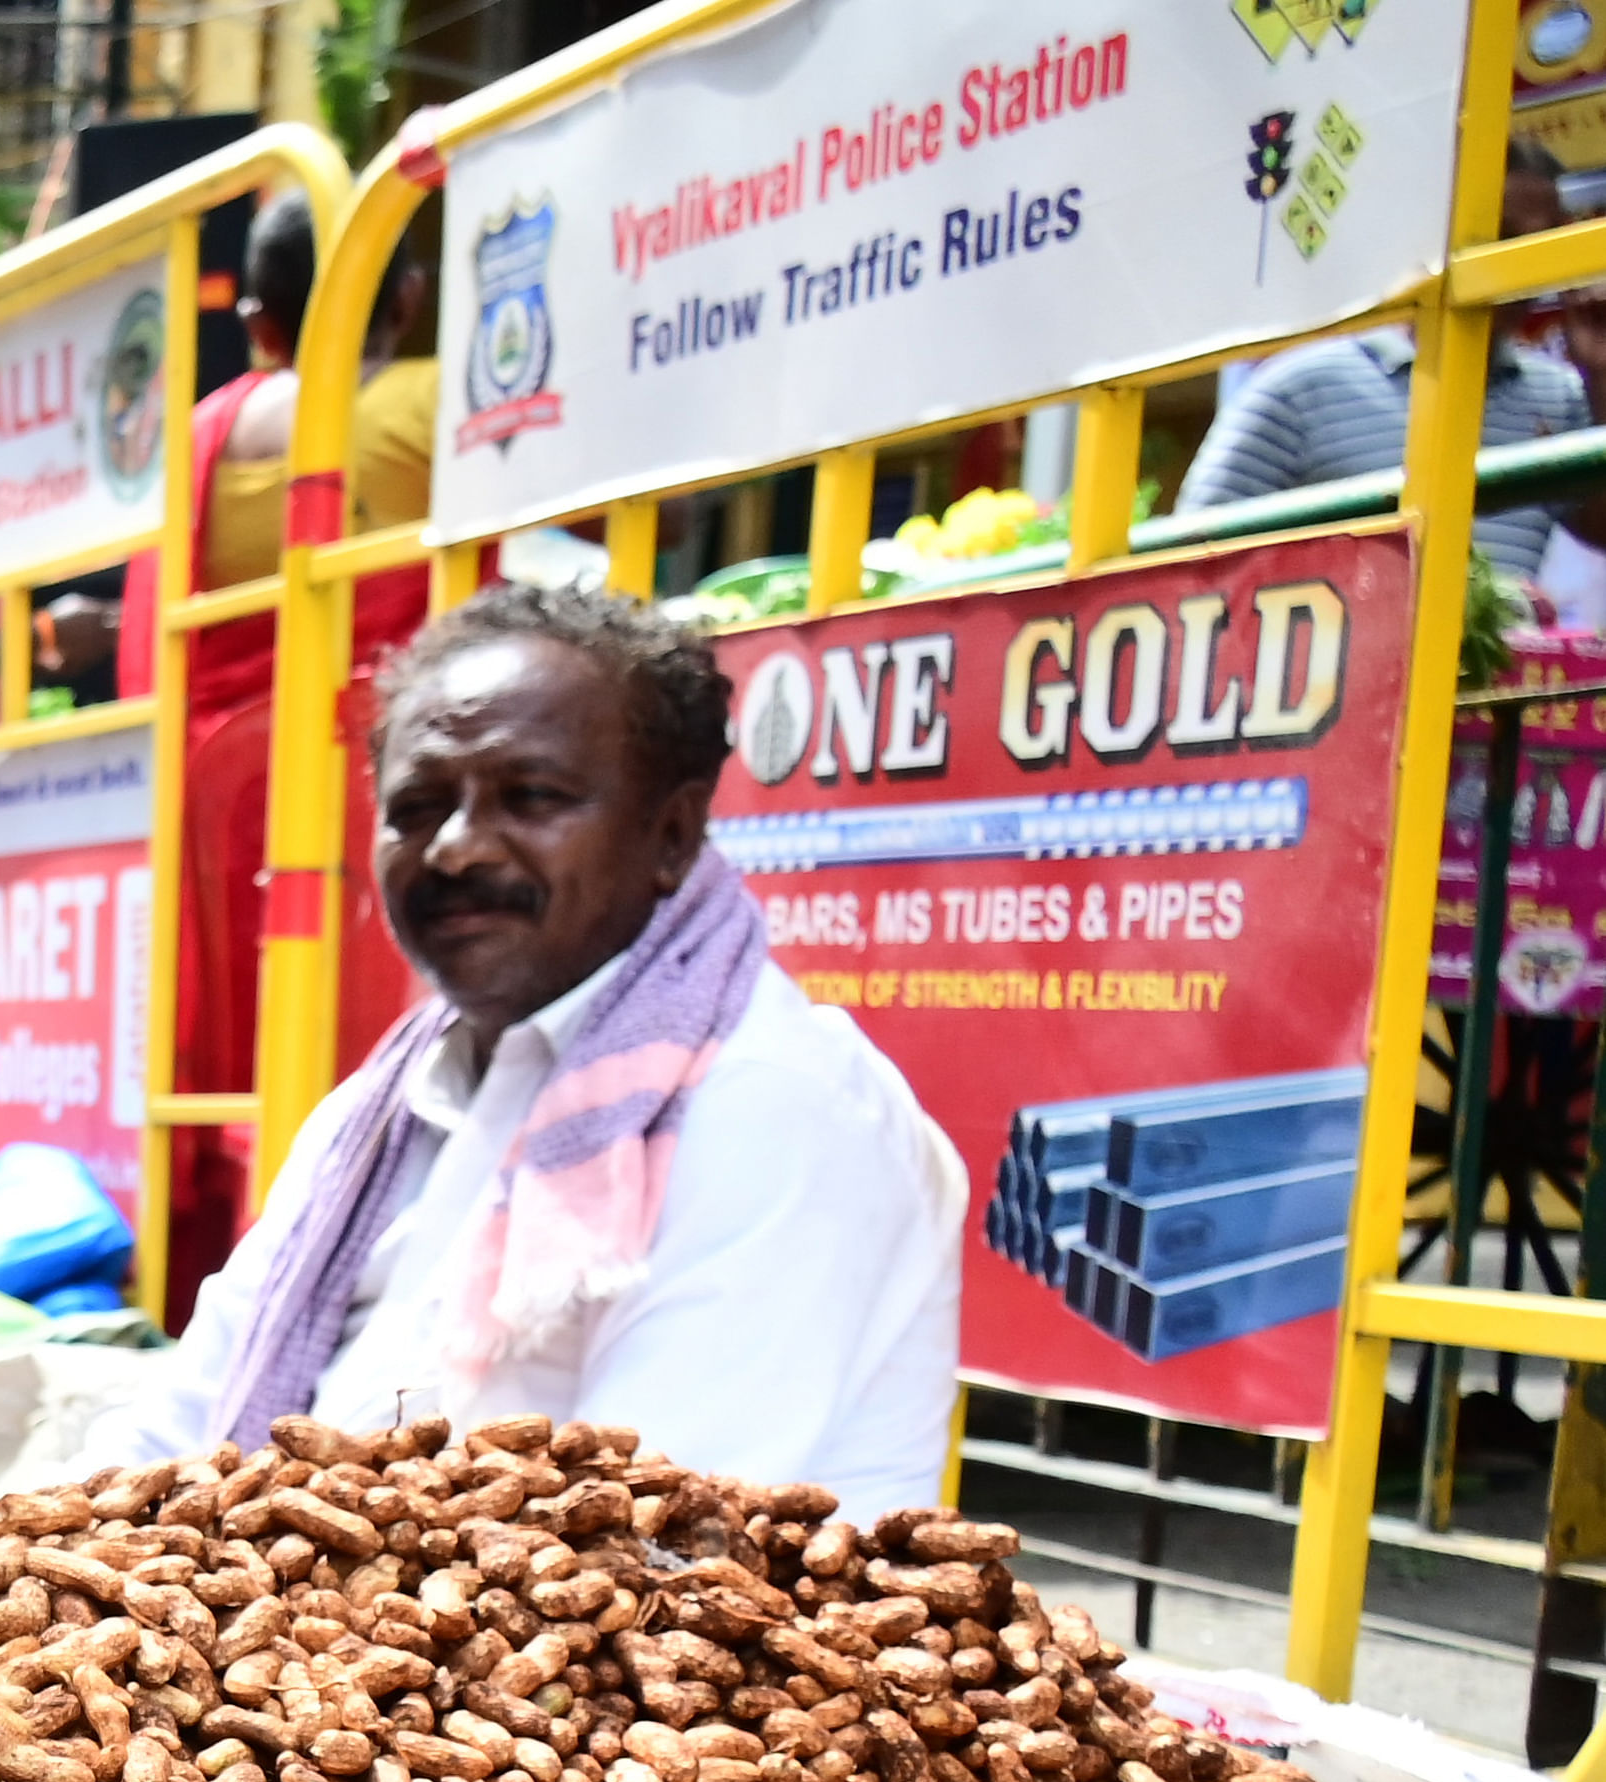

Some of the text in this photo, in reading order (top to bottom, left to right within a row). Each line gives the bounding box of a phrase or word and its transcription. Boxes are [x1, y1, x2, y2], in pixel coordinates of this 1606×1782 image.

[611, 139, 805, 280] Vyalikaval
[818, 102, 944, 203] Police
[958, 30, 1129, 150] Station
[629, 186, 1084, 372] Follow Traffic Rules
[727, 634, 953, 784] ONE
[999, 580, 1349, 769] GOLD
[767, 878, 1244, 952] BARS, MS TUBES & PIPES
[865, 970, 899, 1008] OF
[902, 970, 1039, 1010] STRENGTH
[1041, 968, 1063, 1010] &
[1068, 970, 1227, 1011] FLEXIBILITY
